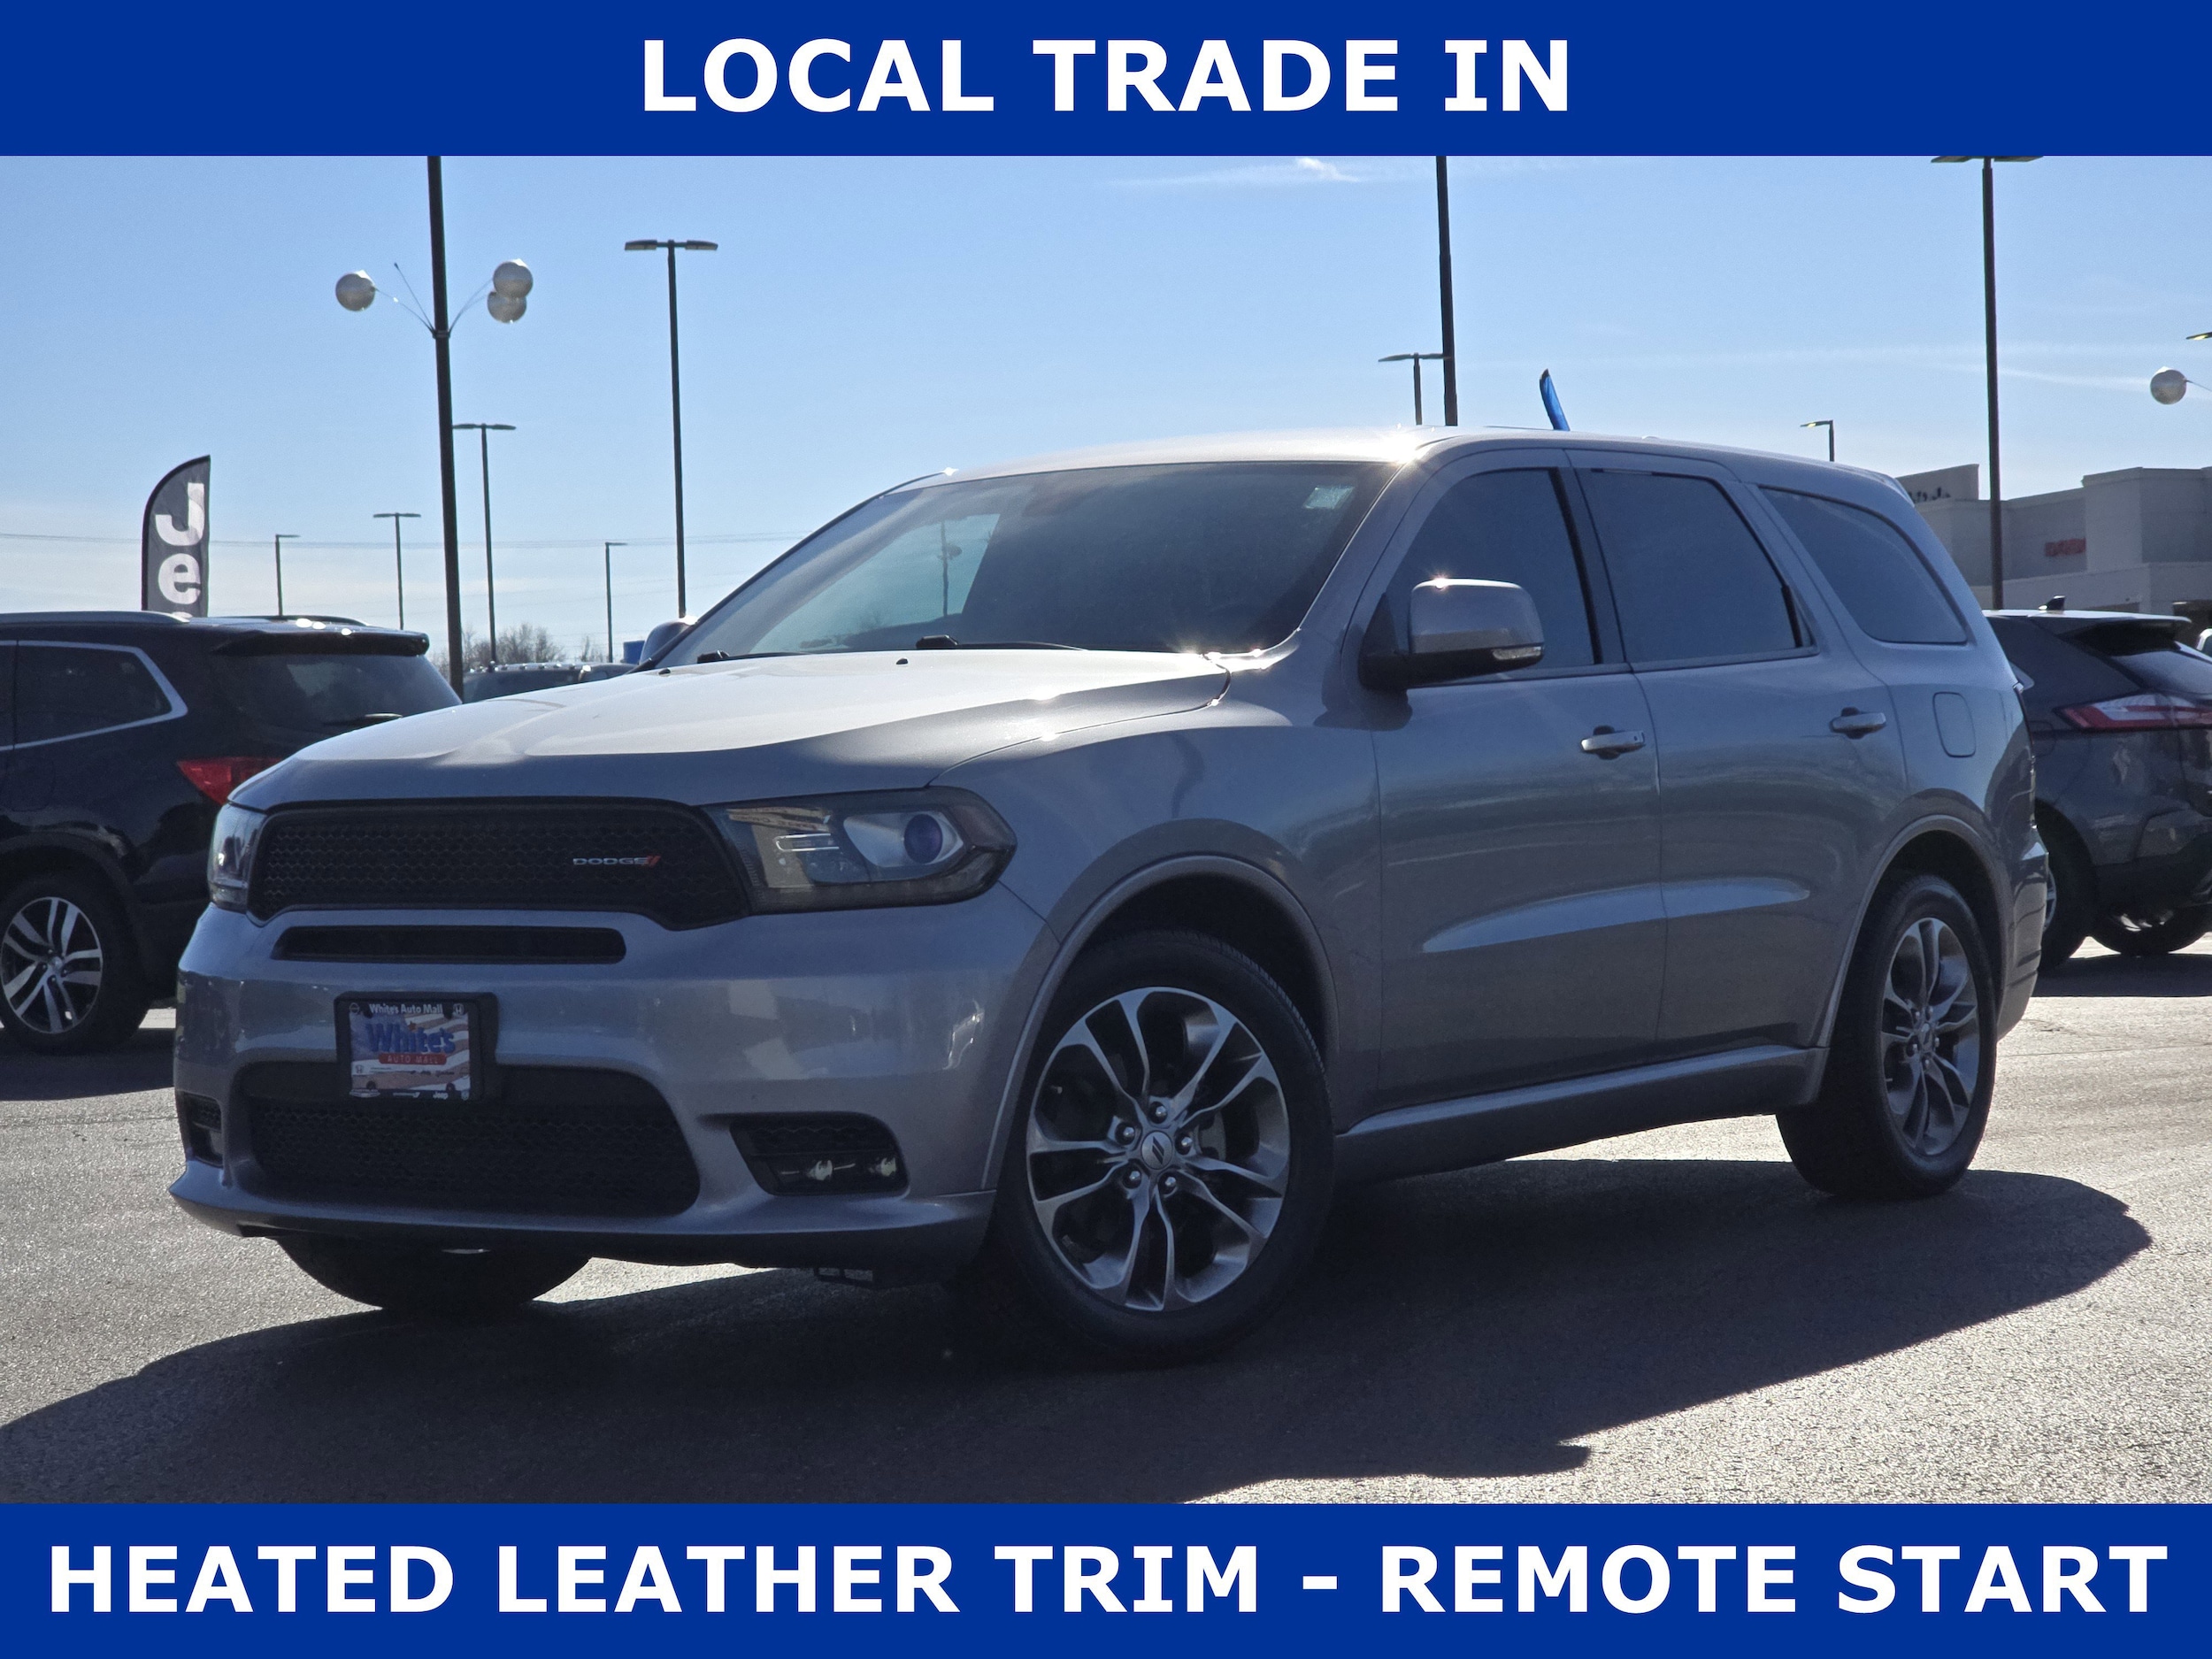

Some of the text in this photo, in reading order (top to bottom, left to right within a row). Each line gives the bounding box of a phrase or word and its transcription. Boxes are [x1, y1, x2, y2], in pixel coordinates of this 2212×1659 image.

[572, 856, 649, 865] DODGE
[368, 1003, 443, 1015] White's Auto Mall
[365, 1022, 456, 1054] White's
[388, 1055, 439, 1064] AUTO MALL
